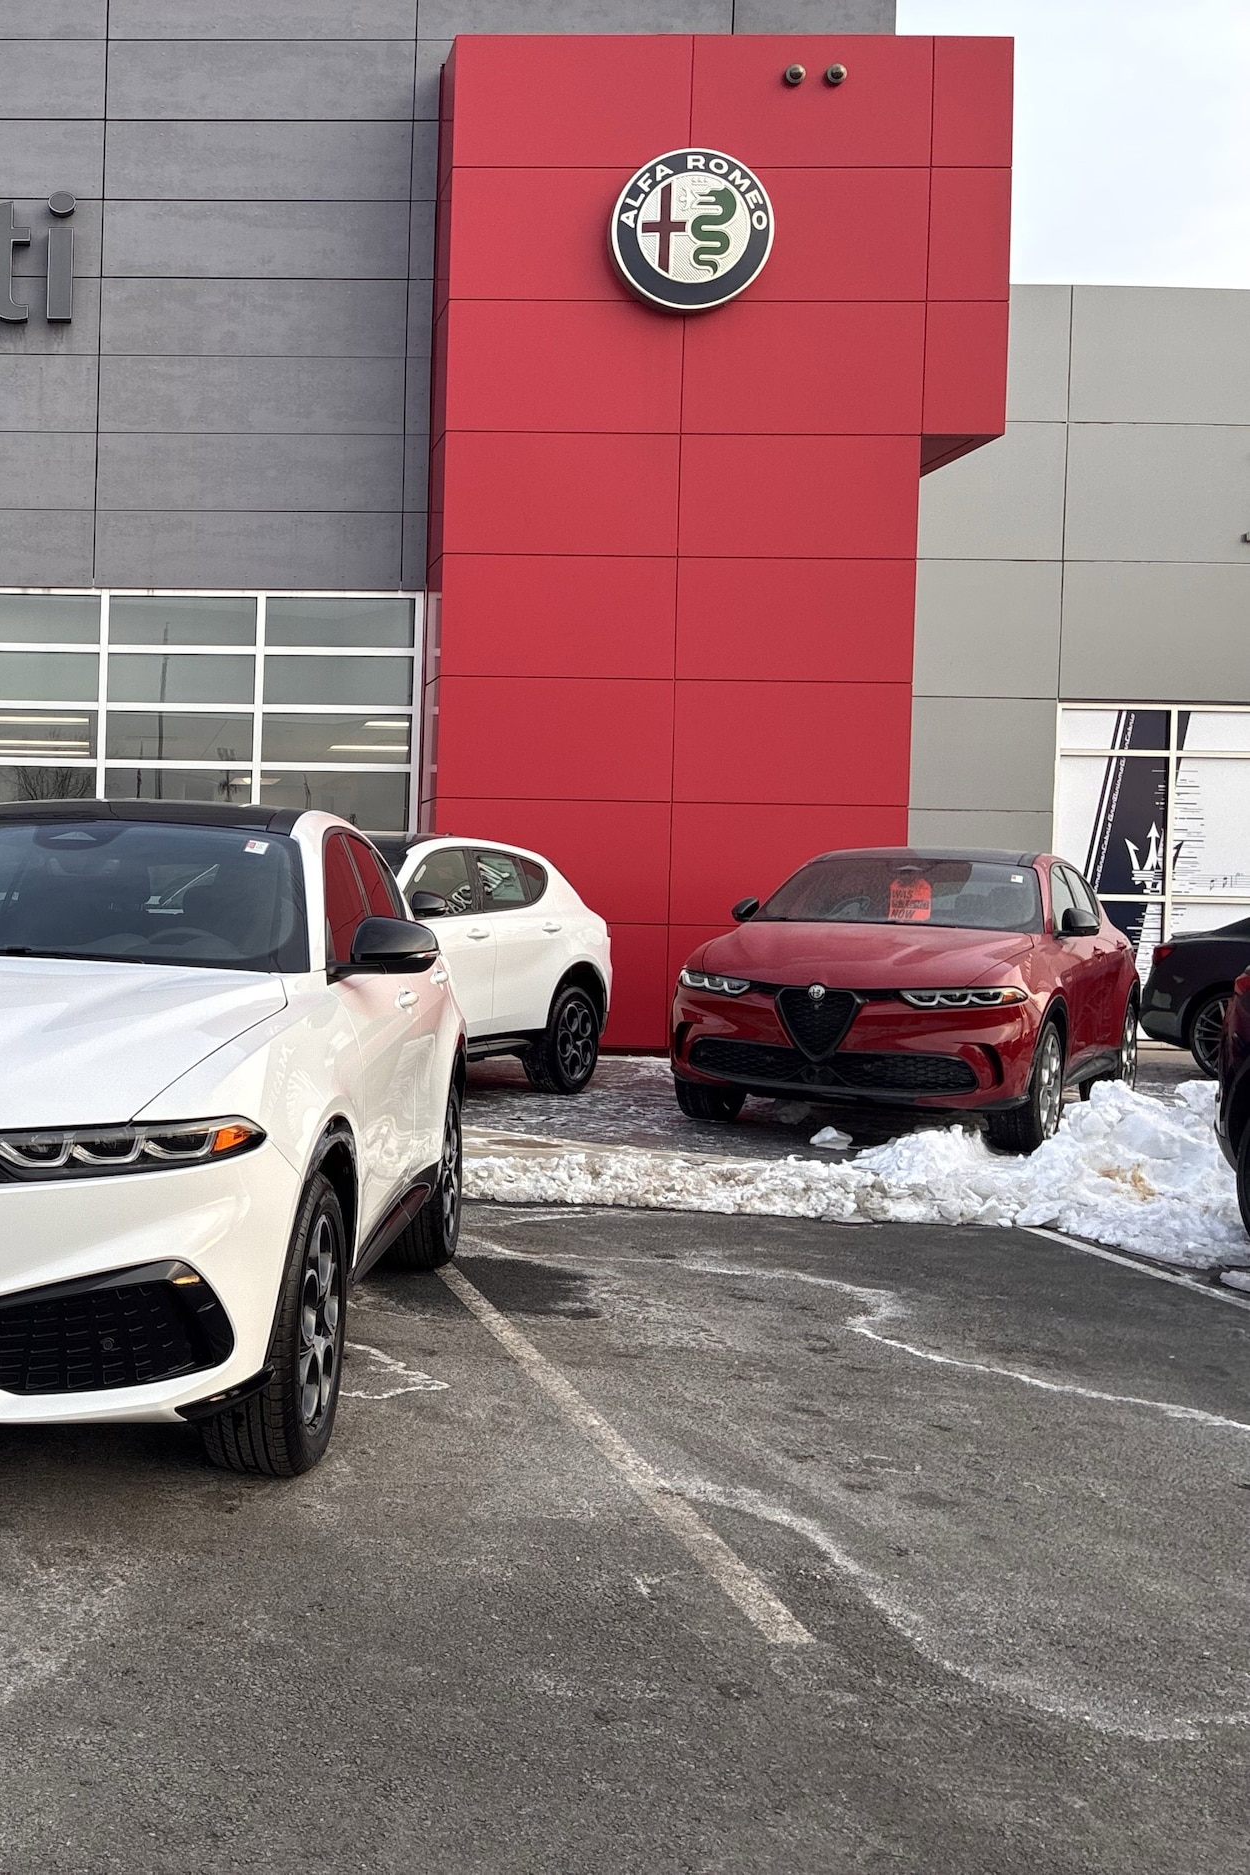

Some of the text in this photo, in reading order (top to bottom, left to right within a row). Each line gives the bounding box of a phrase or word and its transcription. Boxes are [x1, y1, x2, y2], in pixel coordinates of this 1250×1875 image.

[620, 155, 768, 231] ALFA ROMEO
[892, 889, 913, 899] WAS
[891, 909, 916, 919] NOW
